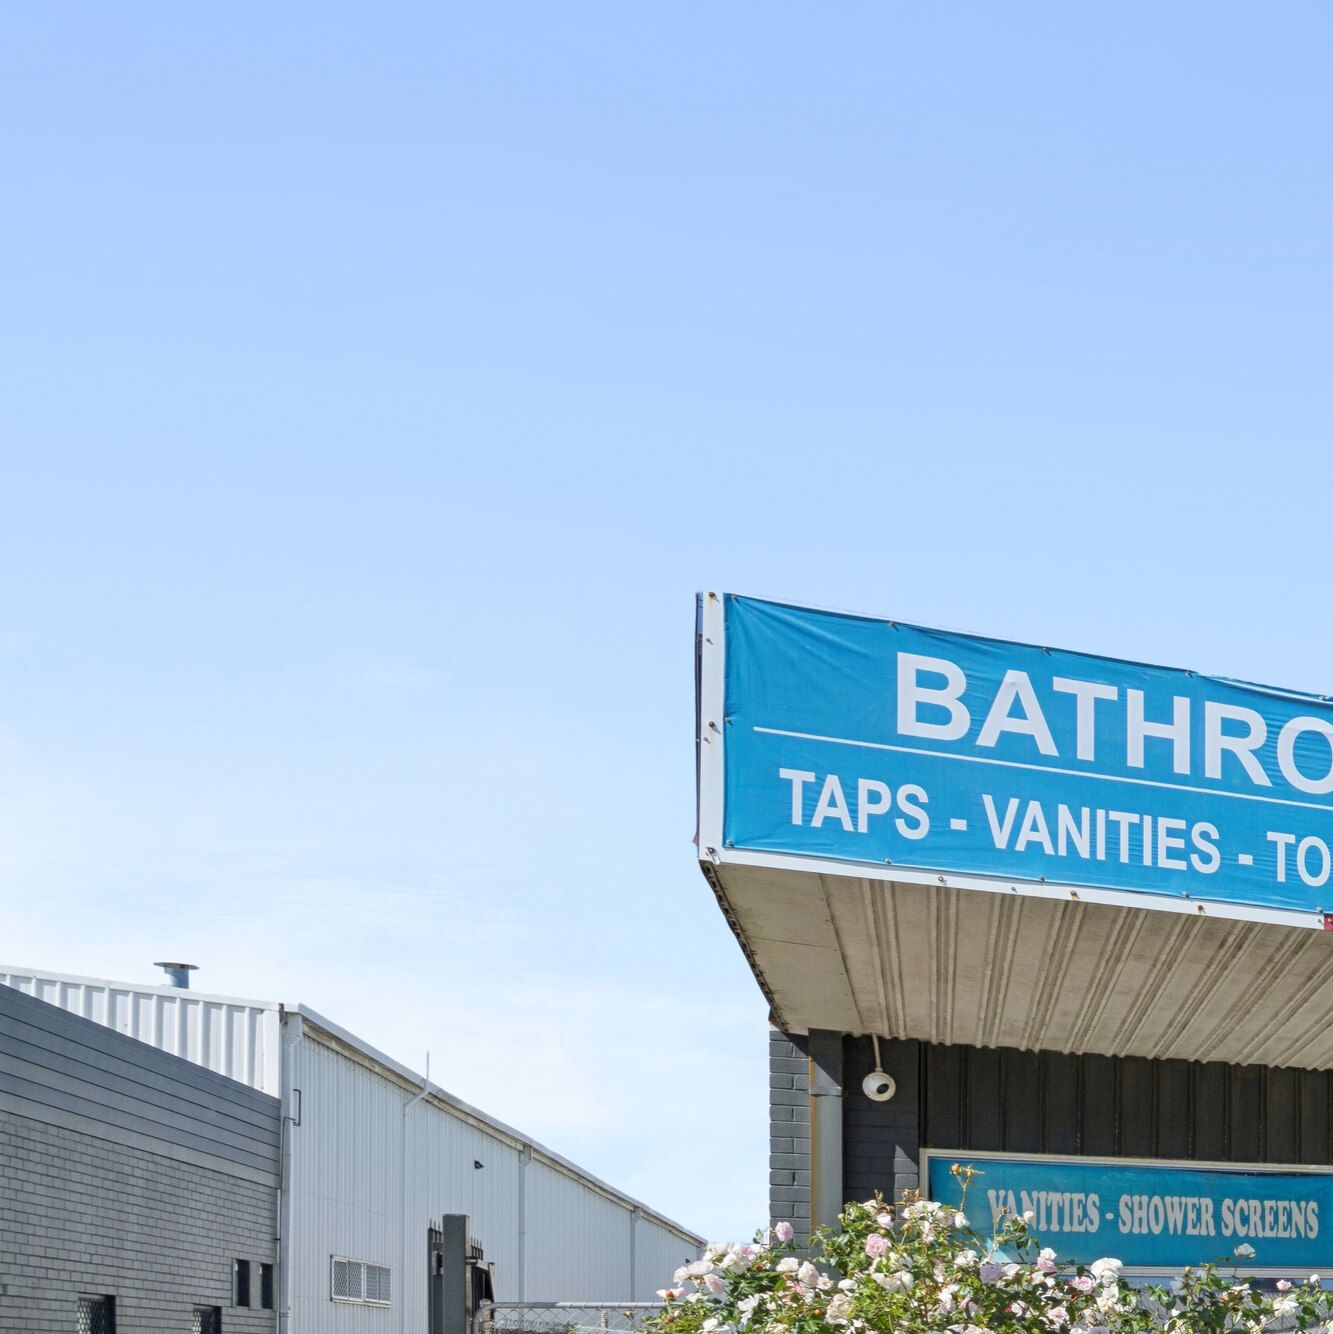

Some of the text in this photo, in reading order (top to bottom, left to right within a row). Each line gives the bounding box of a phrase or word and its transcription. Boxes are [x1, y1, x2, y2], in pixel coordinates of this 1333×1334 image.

[779, 768, 930, 839] TAPS
[982, 794, 1221, 874] VANITIES
[987, 1189, 1100, 1233] VANITIES
[1118, 1194, 1216, 1237] SHOWER
[1221, 1198, 1319, 1240] SCREENS
